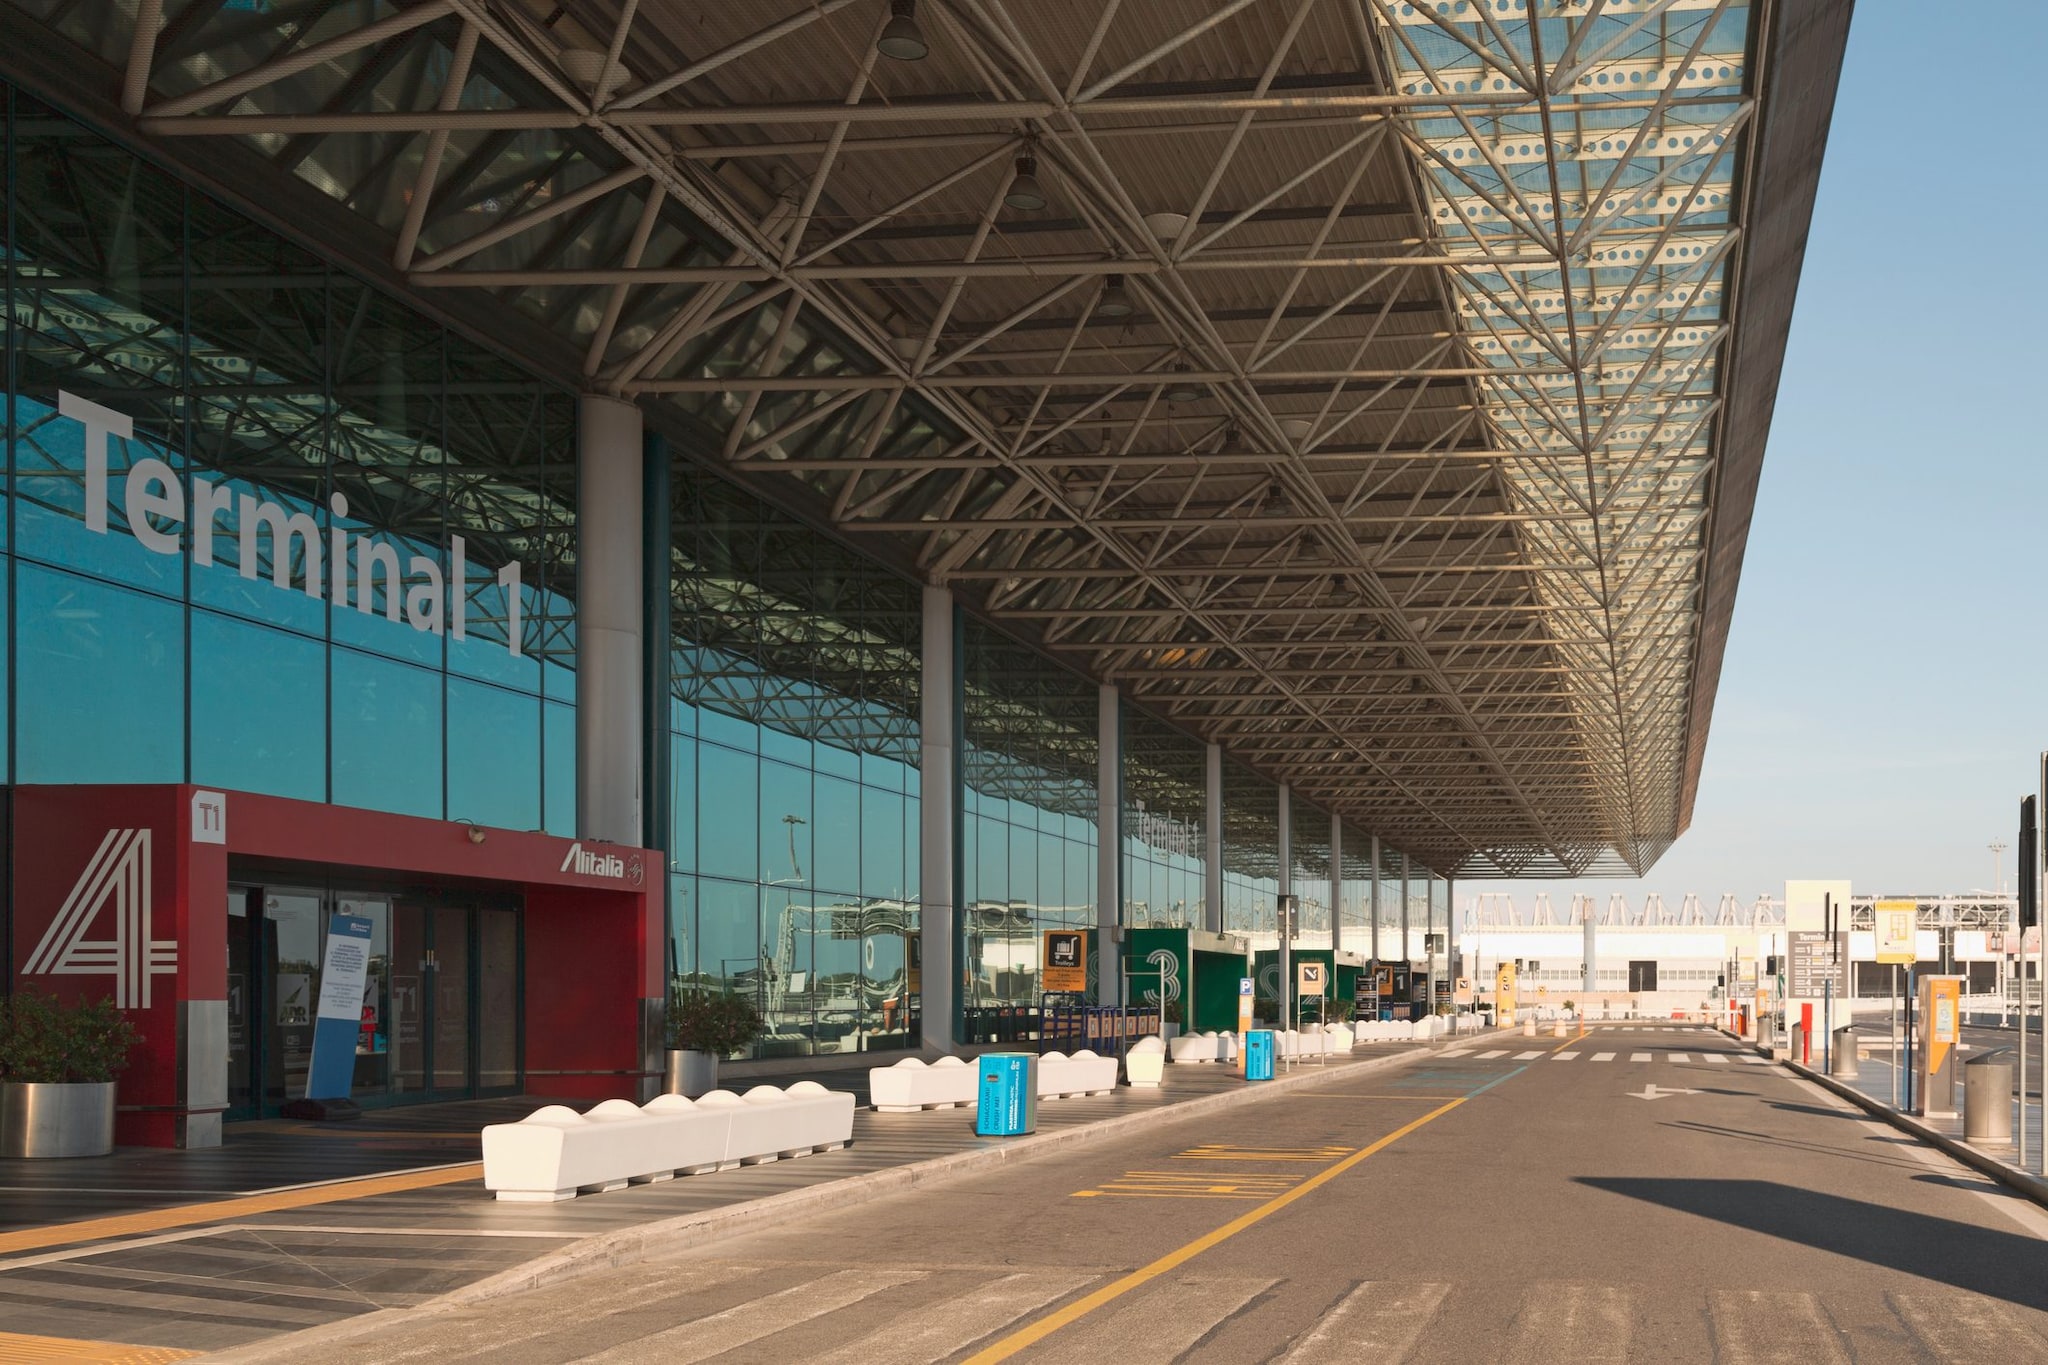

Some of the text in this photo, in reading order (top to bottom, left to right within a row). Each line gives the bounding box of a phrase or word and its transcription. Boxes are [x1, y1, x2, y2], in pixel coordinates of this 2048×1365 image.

[58, 388, 522, 658] Terminal 1
[198, 802, 220, 831] T1
[560, 842, 625, 878] Alitalia
[20, 828, 178, 1009] 4
[1798, 932, 1833, 941] Terminl
[1143, 949, 1181, 1006] 3
[1242, 980, 1251, 993] P
[1396, 974, 1404, 990] 1
[394, 986, 417, 1012] T1
